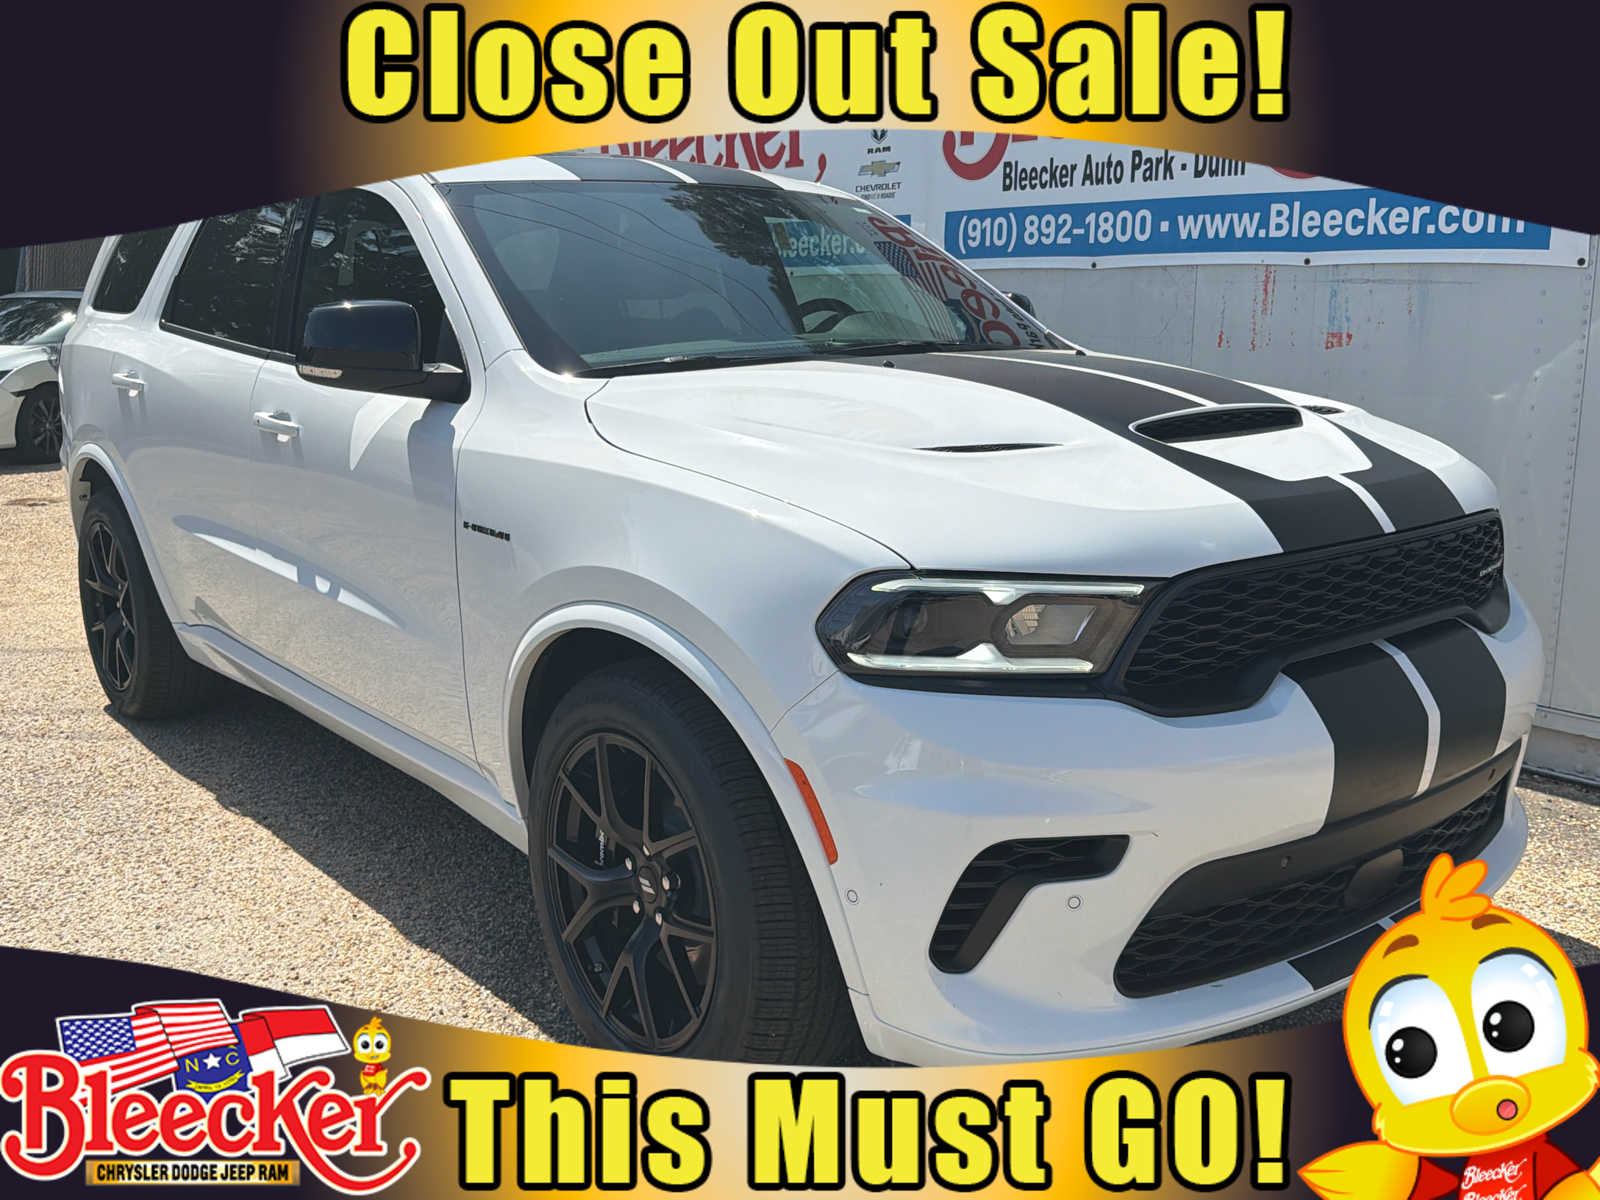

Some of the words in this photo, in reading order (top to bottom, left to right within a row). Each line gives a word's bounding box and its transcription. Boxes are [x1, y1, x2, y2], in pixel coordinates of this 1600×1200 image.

[867, 145, 892, 155] RAM
[1002, 157, 1078, 192] Bleecker
[1081, 153, 1124, 187] Auto
[1130, 149, 1175, 183] Park
[855, 181, 902, 193] CHEVROLET
[958, 212, 1017, 254] (910)
[1023, 208, 1152, 245] 892-1800
[1177, 197, 1526, 240] www.Bleecker.com
